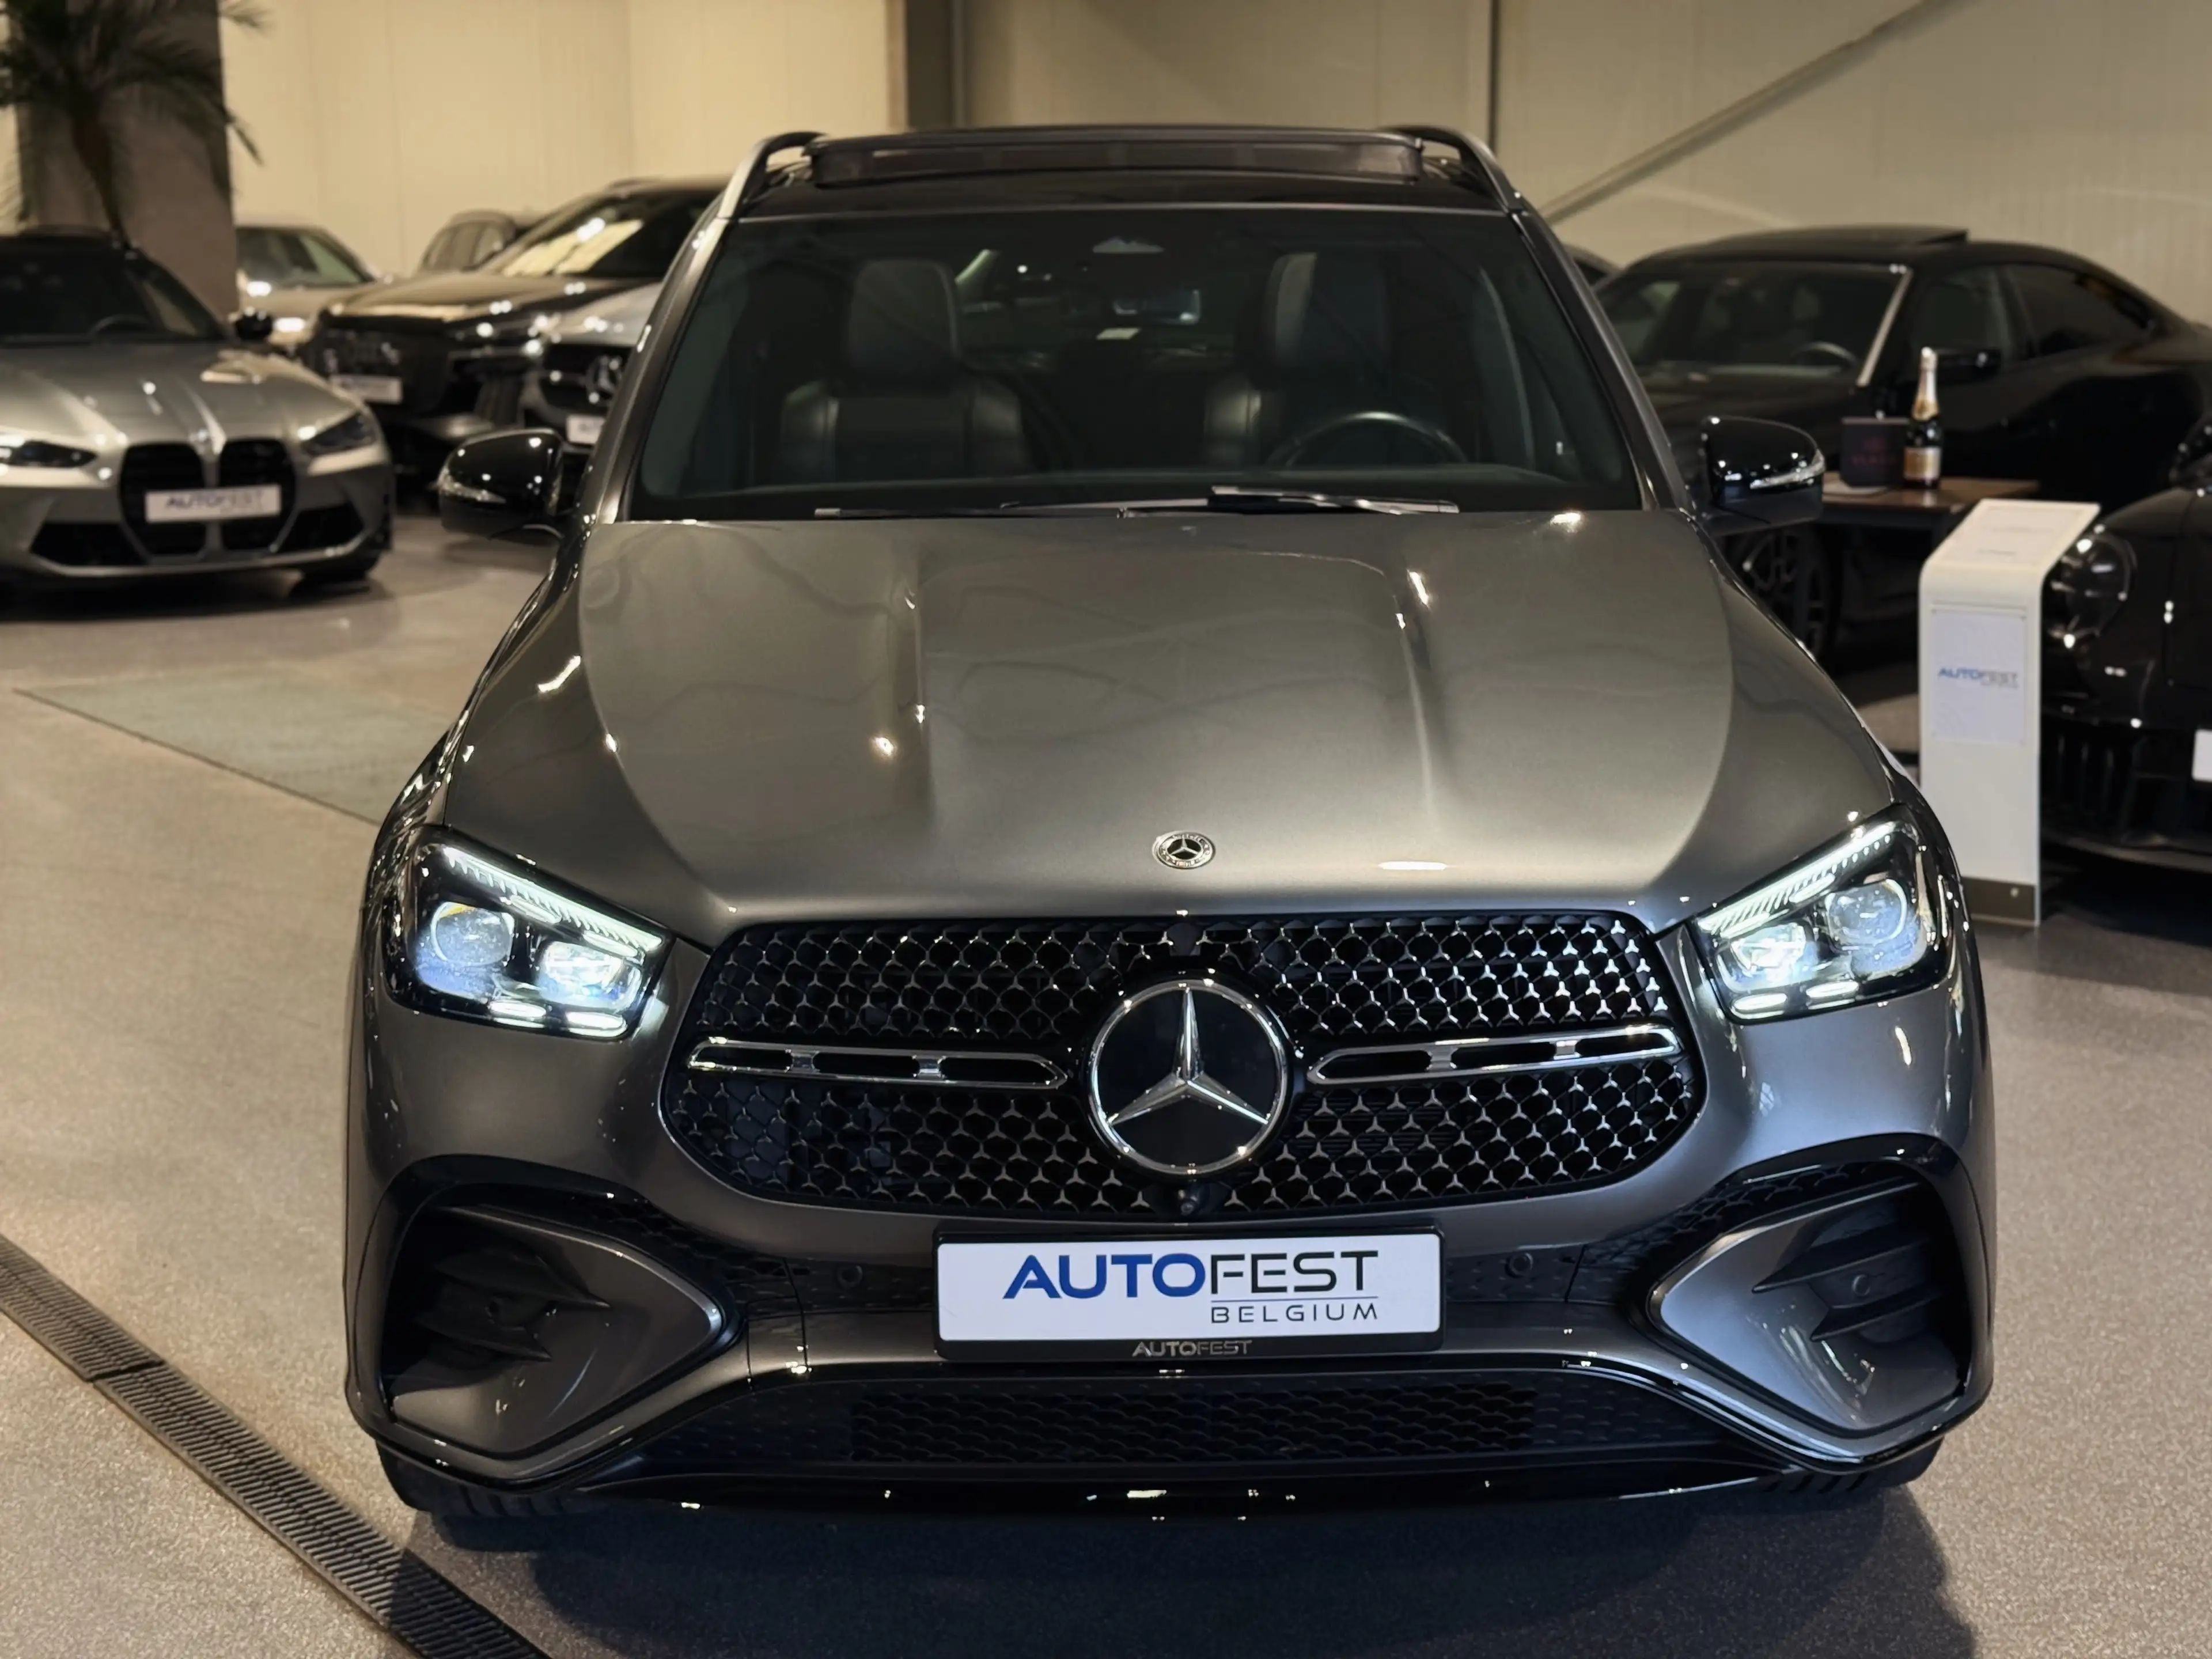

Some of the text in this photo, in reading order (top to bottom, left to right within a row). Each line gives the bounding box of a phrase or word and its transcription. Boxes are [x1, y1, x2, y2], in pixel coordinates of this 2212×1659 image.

[1003, 1251, 1378, 1299] AUTOFEST
[1211, 1303, 1377, 1324] BELGIUM
[1132, 1339, 1253, 1357] AUTOFEST
